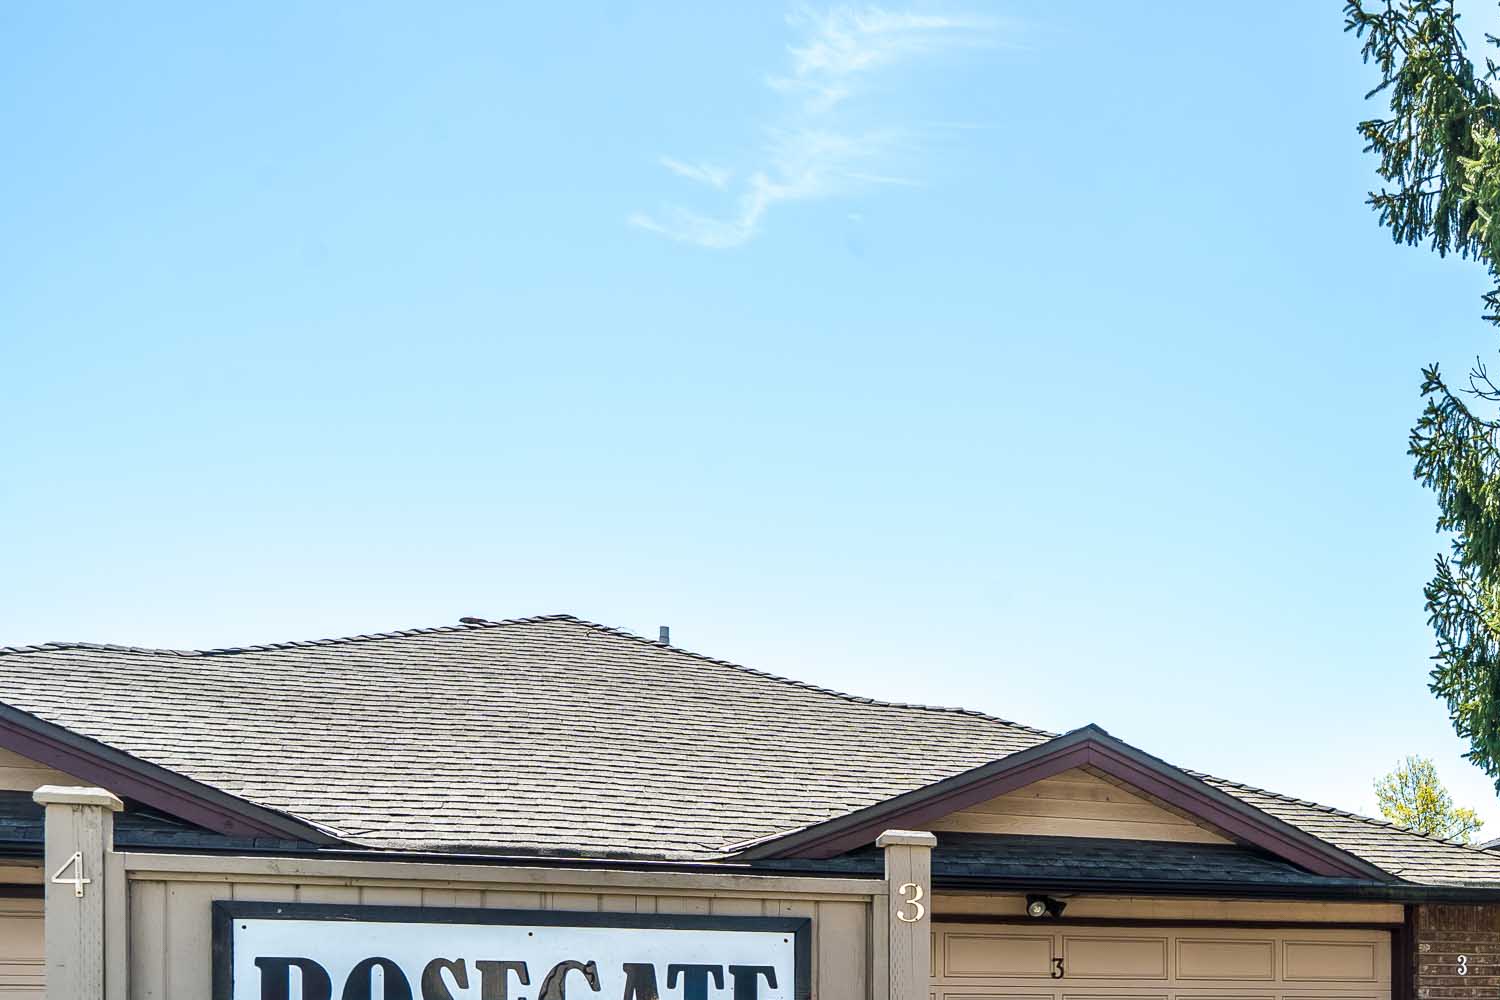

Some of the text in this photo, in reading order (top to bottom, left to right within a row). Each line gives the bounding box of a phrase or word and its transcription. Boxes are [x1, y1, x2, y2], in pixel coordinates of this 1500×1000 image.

[51, 851, 91, 897] 4
[897, 883, 924, 922] 3
[1051, 958, 1064, 979] 3
[1457, 954, 1467, 976] 3
